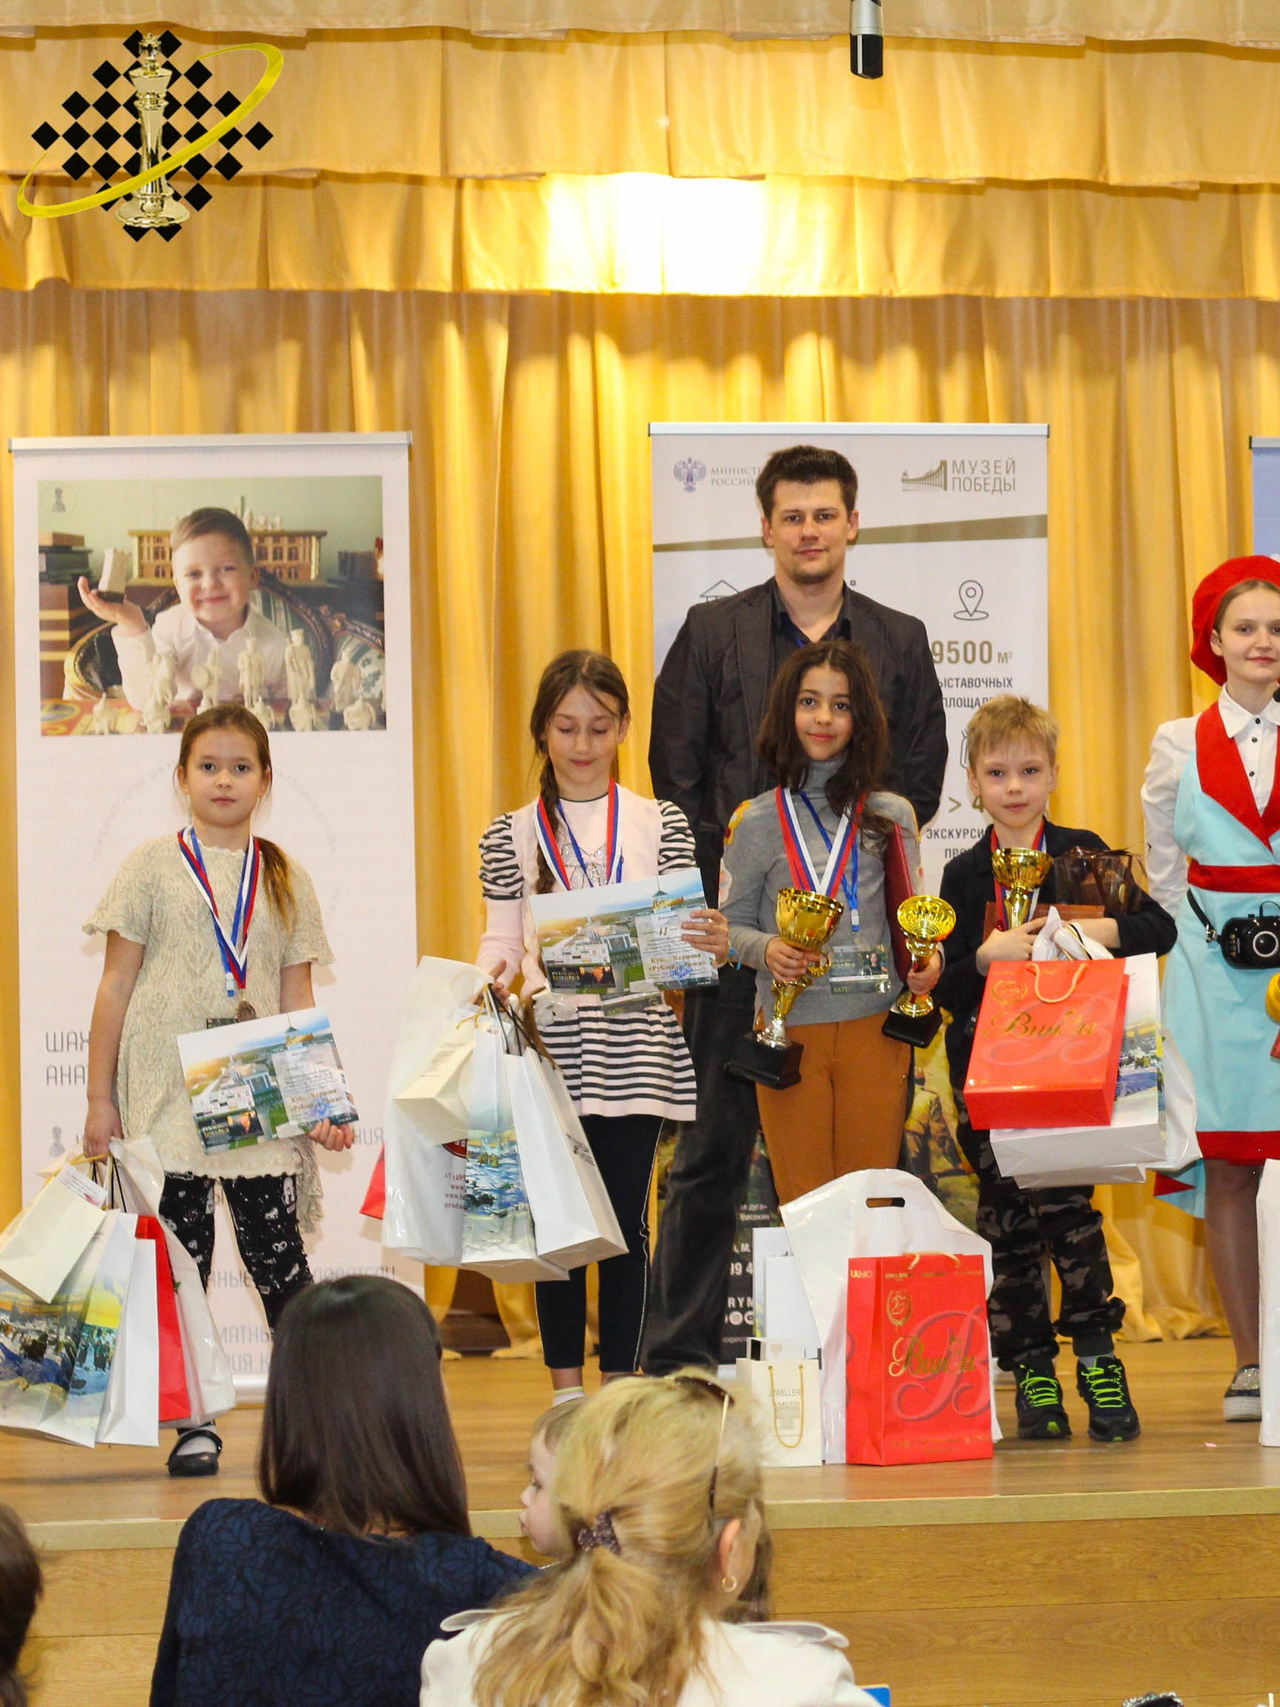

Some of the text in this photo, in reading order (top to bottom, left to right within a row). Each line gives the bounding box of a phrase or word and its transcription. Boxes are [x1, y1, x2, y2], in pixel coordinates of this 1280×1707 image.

[951, 457, 1016, 475] МУЗЕЙ
[951, 476, 1016, 495] ПОБЕДЫ
[931, 640, 993, 665] 9500
[939, 677, 1014, 689] ЫСТАВОЧНЫХ
[926, 828, 986, 840] ЭКСКУРСИ
